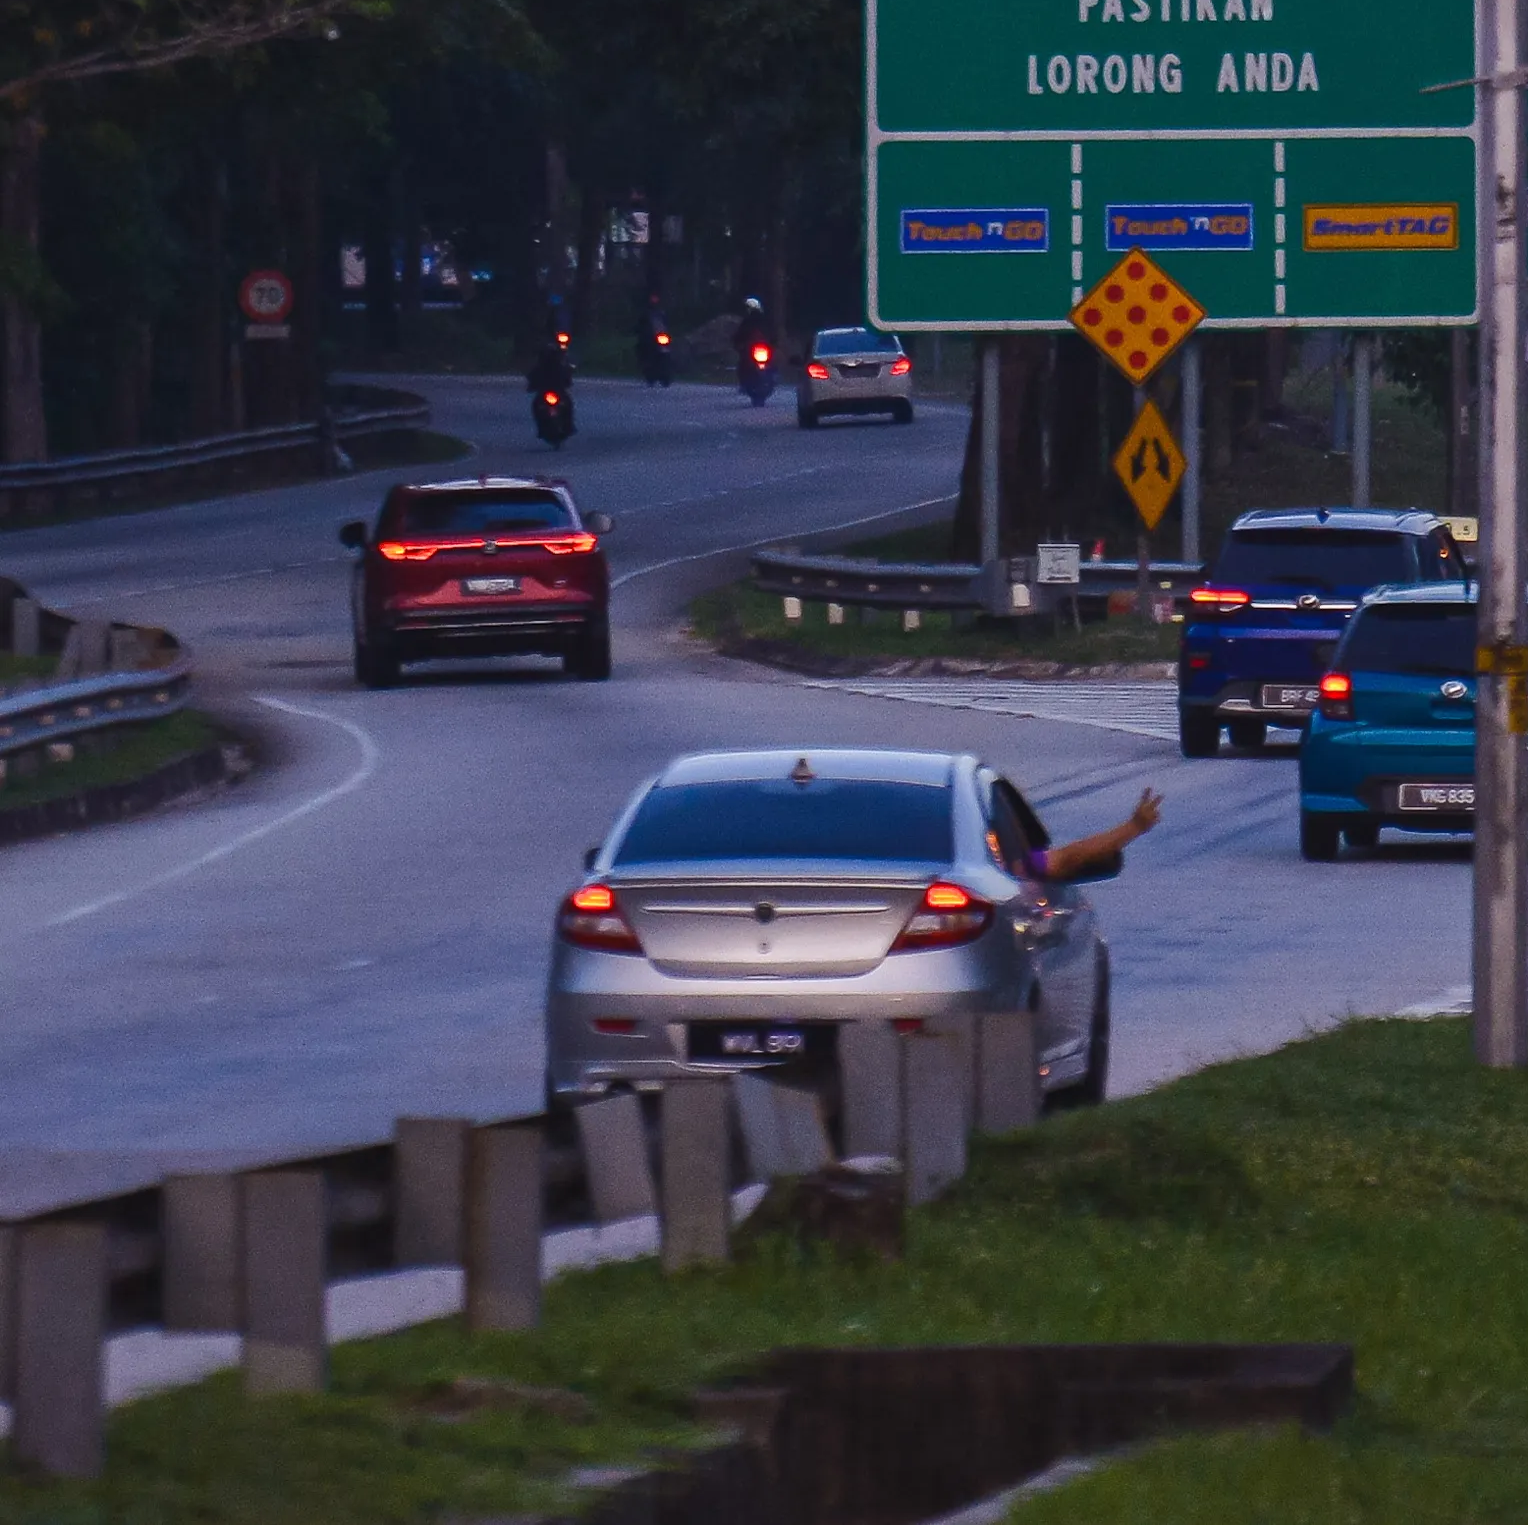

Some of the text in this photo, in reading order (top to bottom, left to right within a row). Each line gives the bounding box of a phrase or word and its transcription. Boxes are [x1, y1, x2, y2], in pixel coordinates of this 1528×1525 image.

[1026, 51, 1320, 94] LORONG ANDA
[908, 221, 983, 240] Touch
[1113, 216, 1187, 235] Touch
